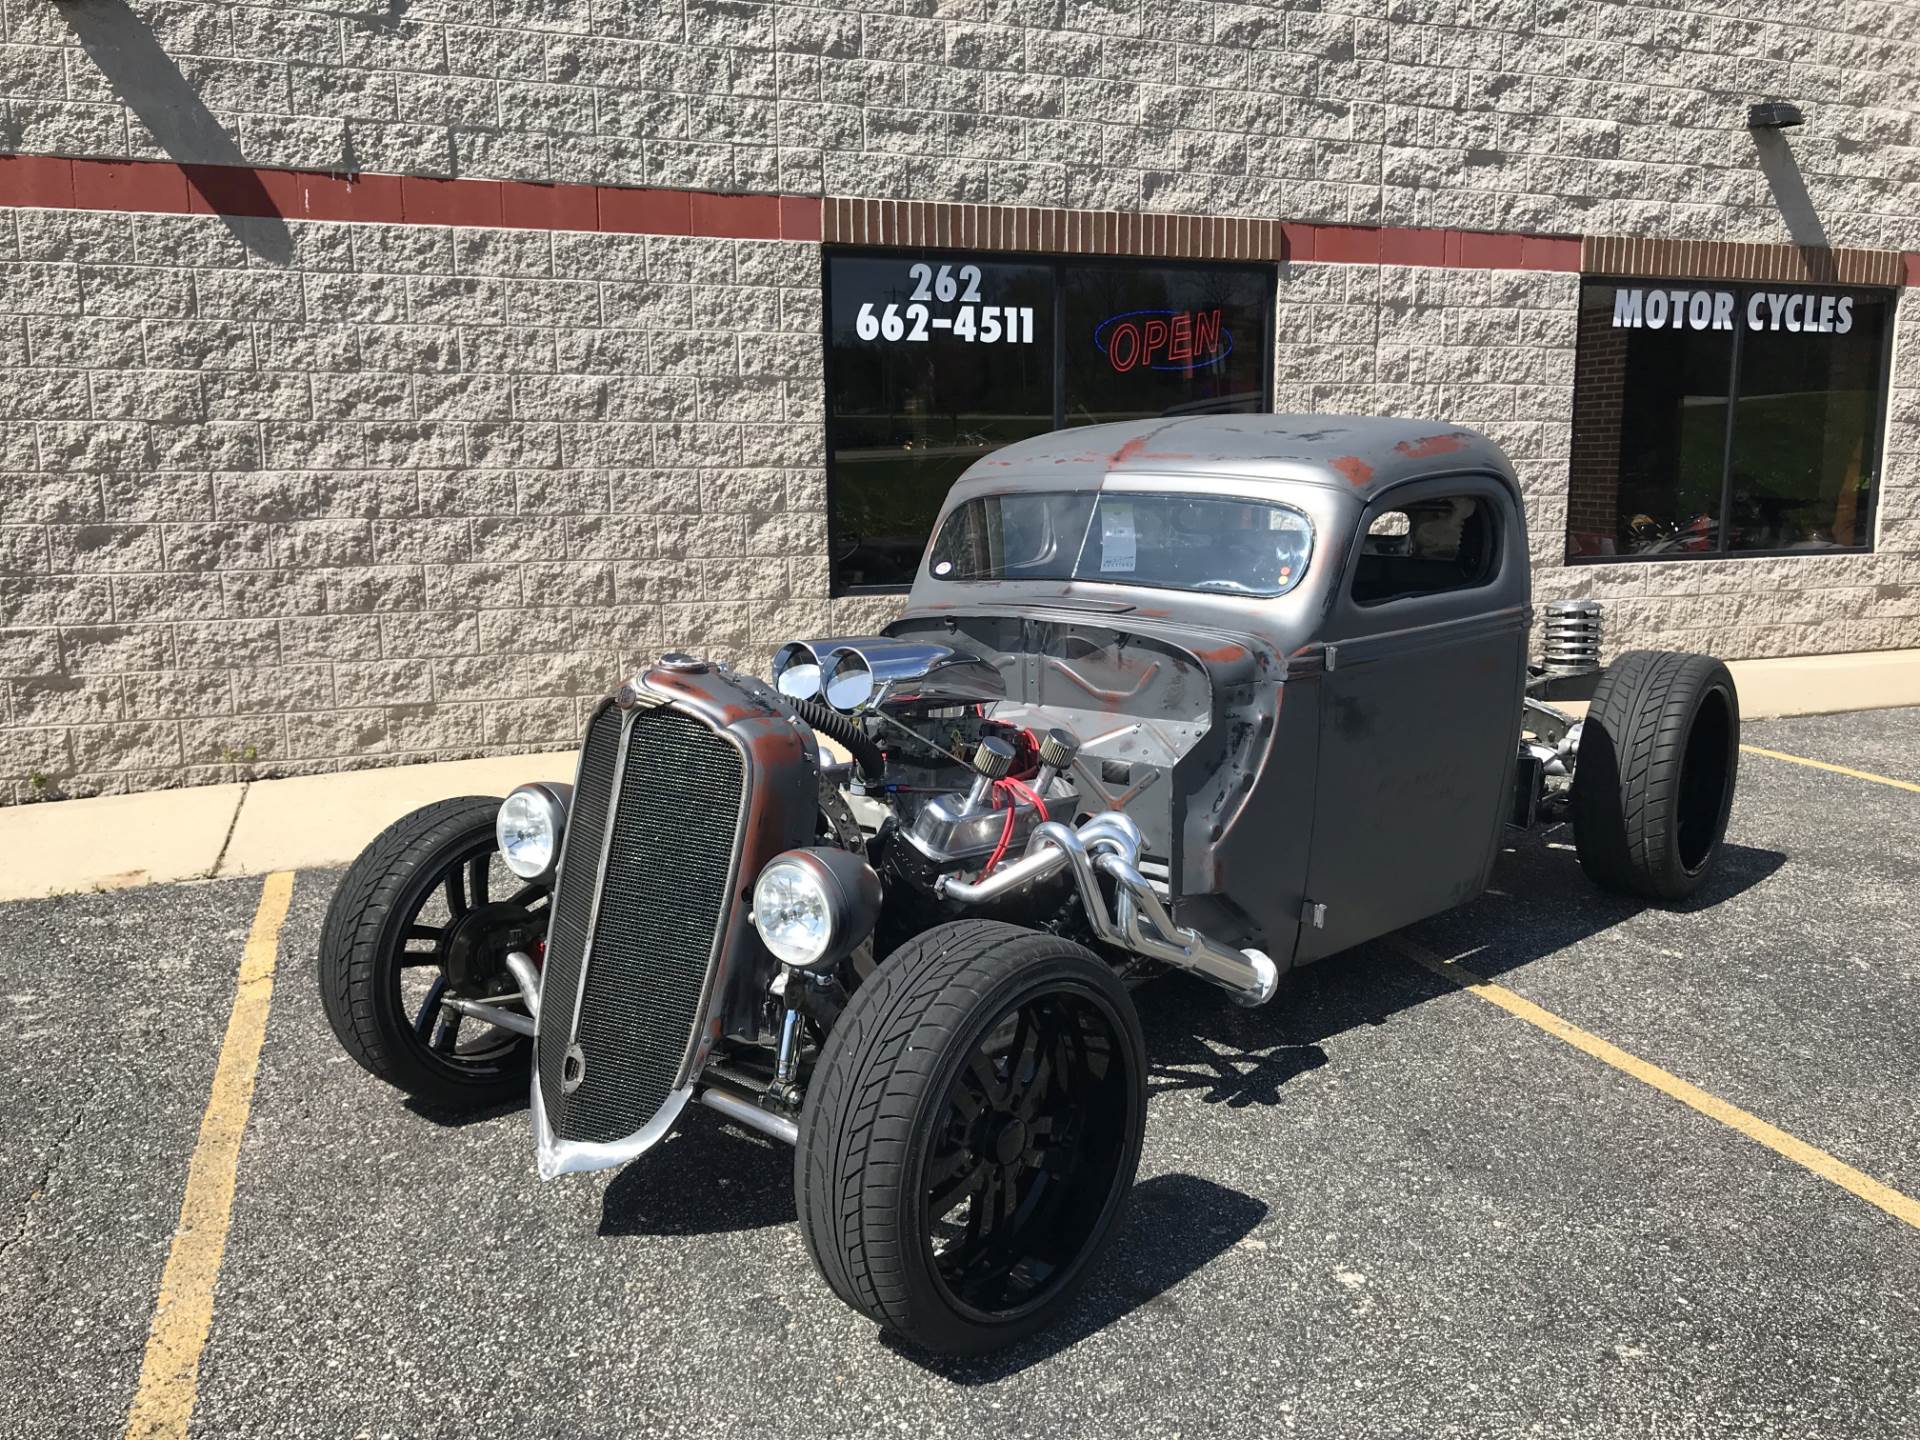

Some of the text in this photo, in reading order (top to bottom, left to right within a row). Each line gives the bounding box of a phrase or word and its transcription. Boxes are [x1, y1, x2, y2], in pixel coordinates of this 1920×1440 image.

[909, 263, 981, 302] 262
[856, 303, 1033, 343] 662-4511
[1612, 289, 1853, 333] MOTOR CYCLES
[1110, 310, 1220, 372] OPEN
